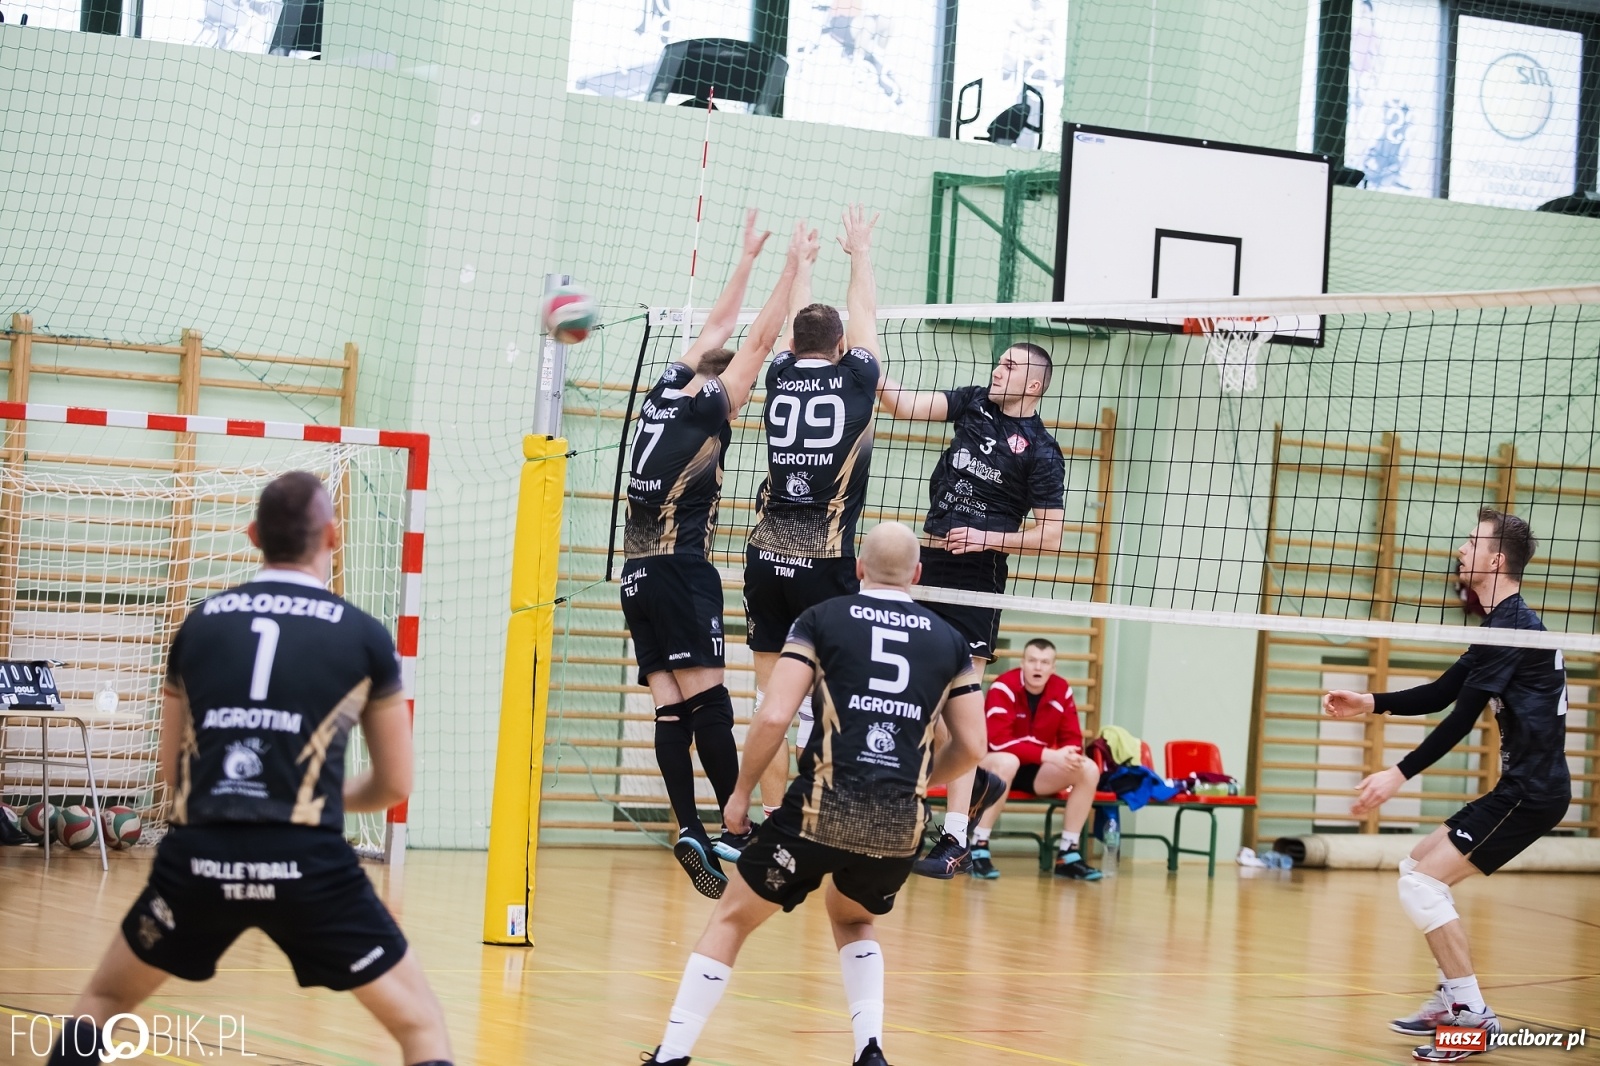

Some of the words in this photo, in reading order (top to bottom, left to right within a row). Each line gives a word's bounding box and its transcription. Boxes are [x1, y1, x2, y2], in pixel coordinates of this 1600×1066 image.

[828, 376, 843, 390] W
[769, 394, 846, 449] 99
[629, 417, 665, 475] 17
[772, 451, 834, 466] AGROTIM
[979, 436, 997, 455] 3
[630, 476, 662, 492] ROTIM
[203, 592, 344, 623] KOŁODZIEJ
[850, 604, 932, 631] GONSIOR
[250, 616, 281, 701] 1
[711, 637, 723, 657] 17
[868, 625, 911, 694] 5
[10, 664, 20, 681] 0
[23, 665, 33, 682] 0
[35, 666, 55, 690] 20
[848, 694, 922, 721] AGROTIM
[202, 707, 303, 735] AGROTIM
[190, 857, 303, 880] VOLLEYBALL
[221, 883, 276, 900] TEAM
